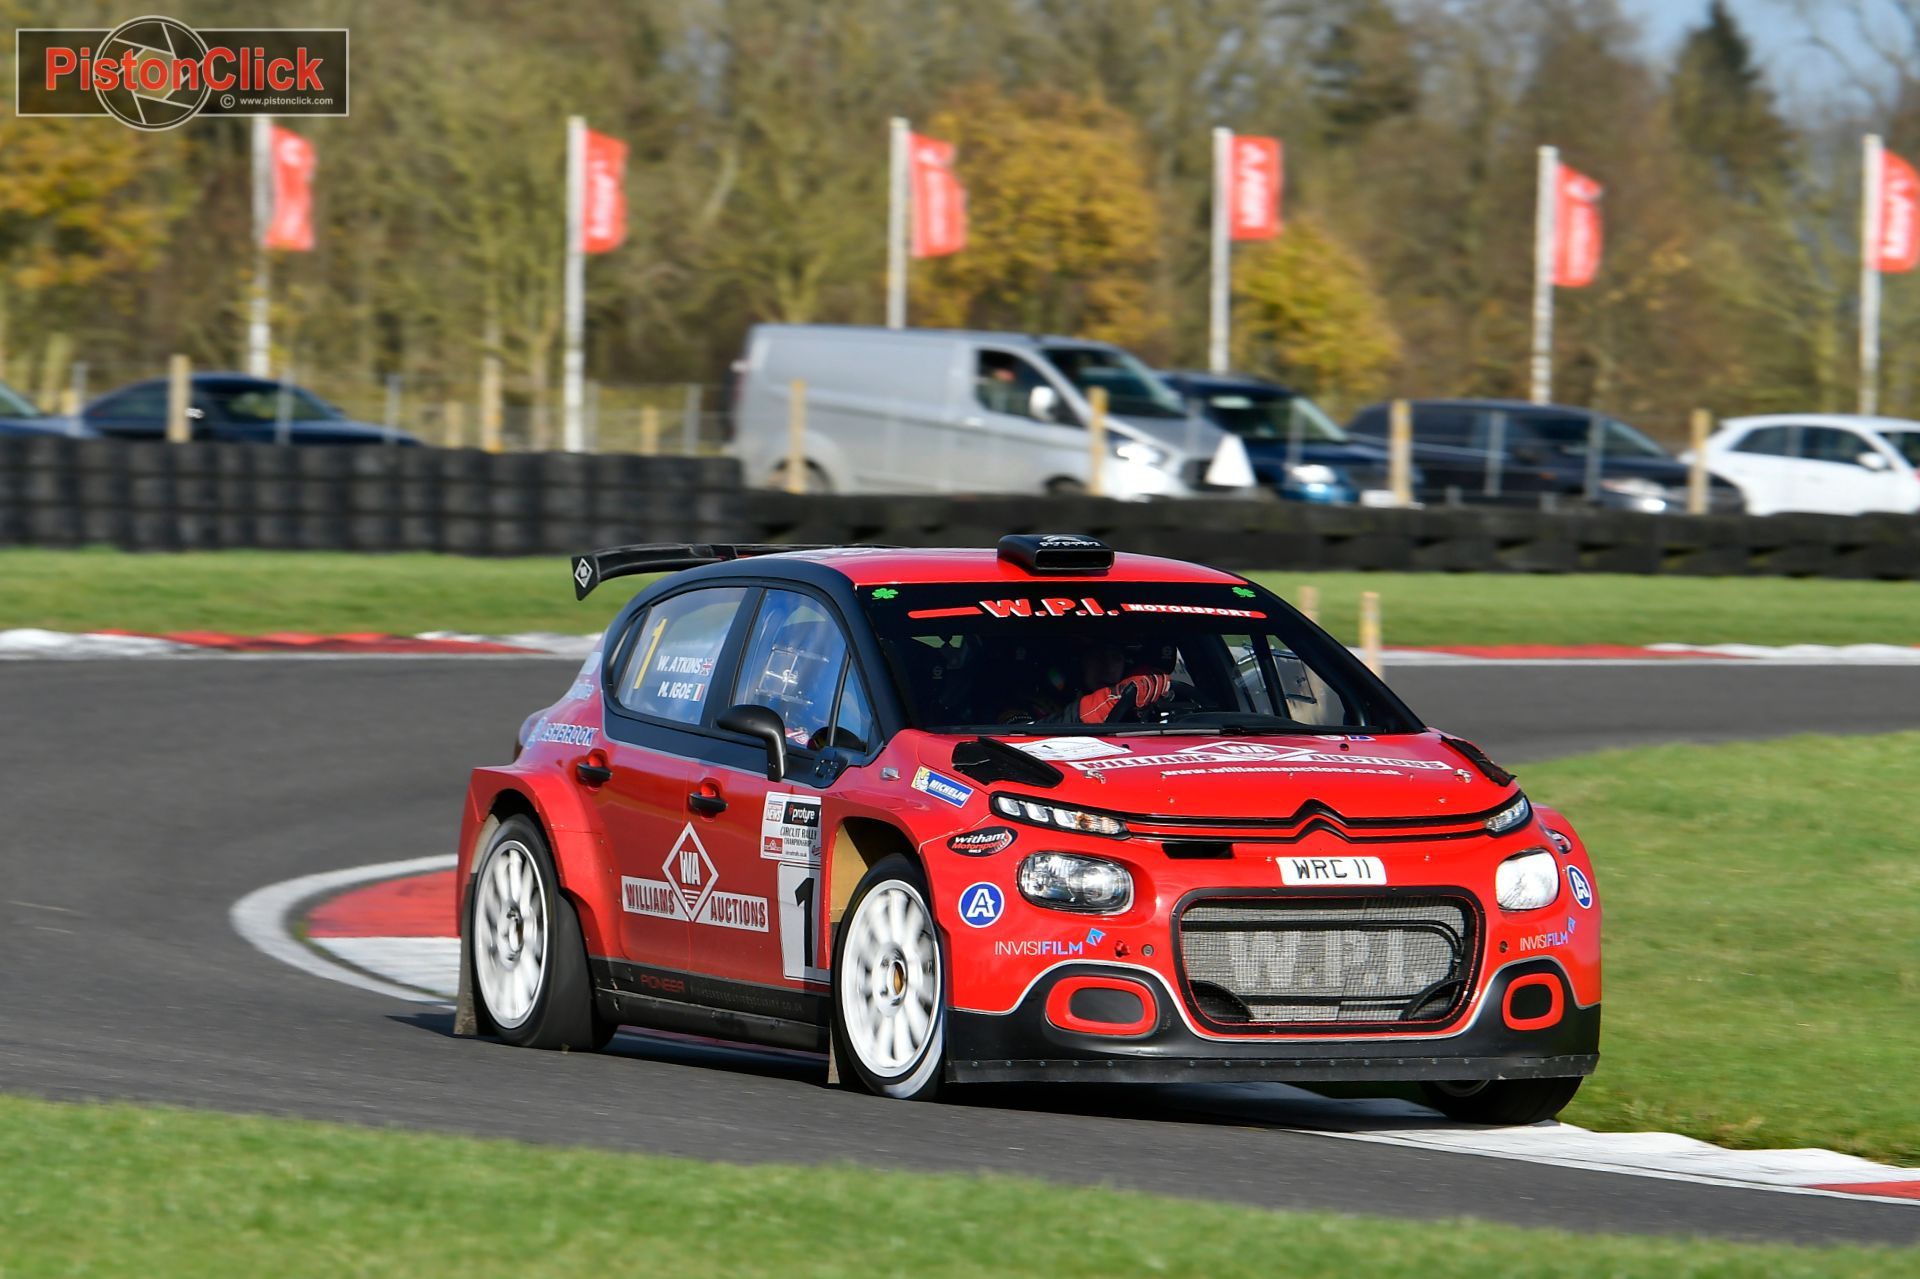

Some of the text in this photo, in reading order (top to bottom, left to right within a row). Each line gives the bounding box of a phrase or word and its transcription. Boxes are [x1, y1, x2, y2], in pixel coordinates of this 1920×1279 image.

[979, 597, 1253, 618] W.P.I. MOTORSPORT
[633, 618, 667, 690] 1
[668, 656, 704, 674] ATKINS
[669, 682, 694, 700] IGOE
[1080, 753, 1445, 770] WILLIAMS AUCTIONS
[929, 779, 970, 802] MICHELIN
[792, 807, 815, 823] protyre
[955, 832, 1006, 844] witham
[679, 850, 702, 885] WA
[1292, 858, 1349, 880] WRC
[625, 883, 767, 929] WILLIAMS AUCTIONS
[795, 877, 815, 968] 1
[995, 940, 1083, 956] INVISIFILM
[1520, 930, 1569, 952] INVISIFILM
